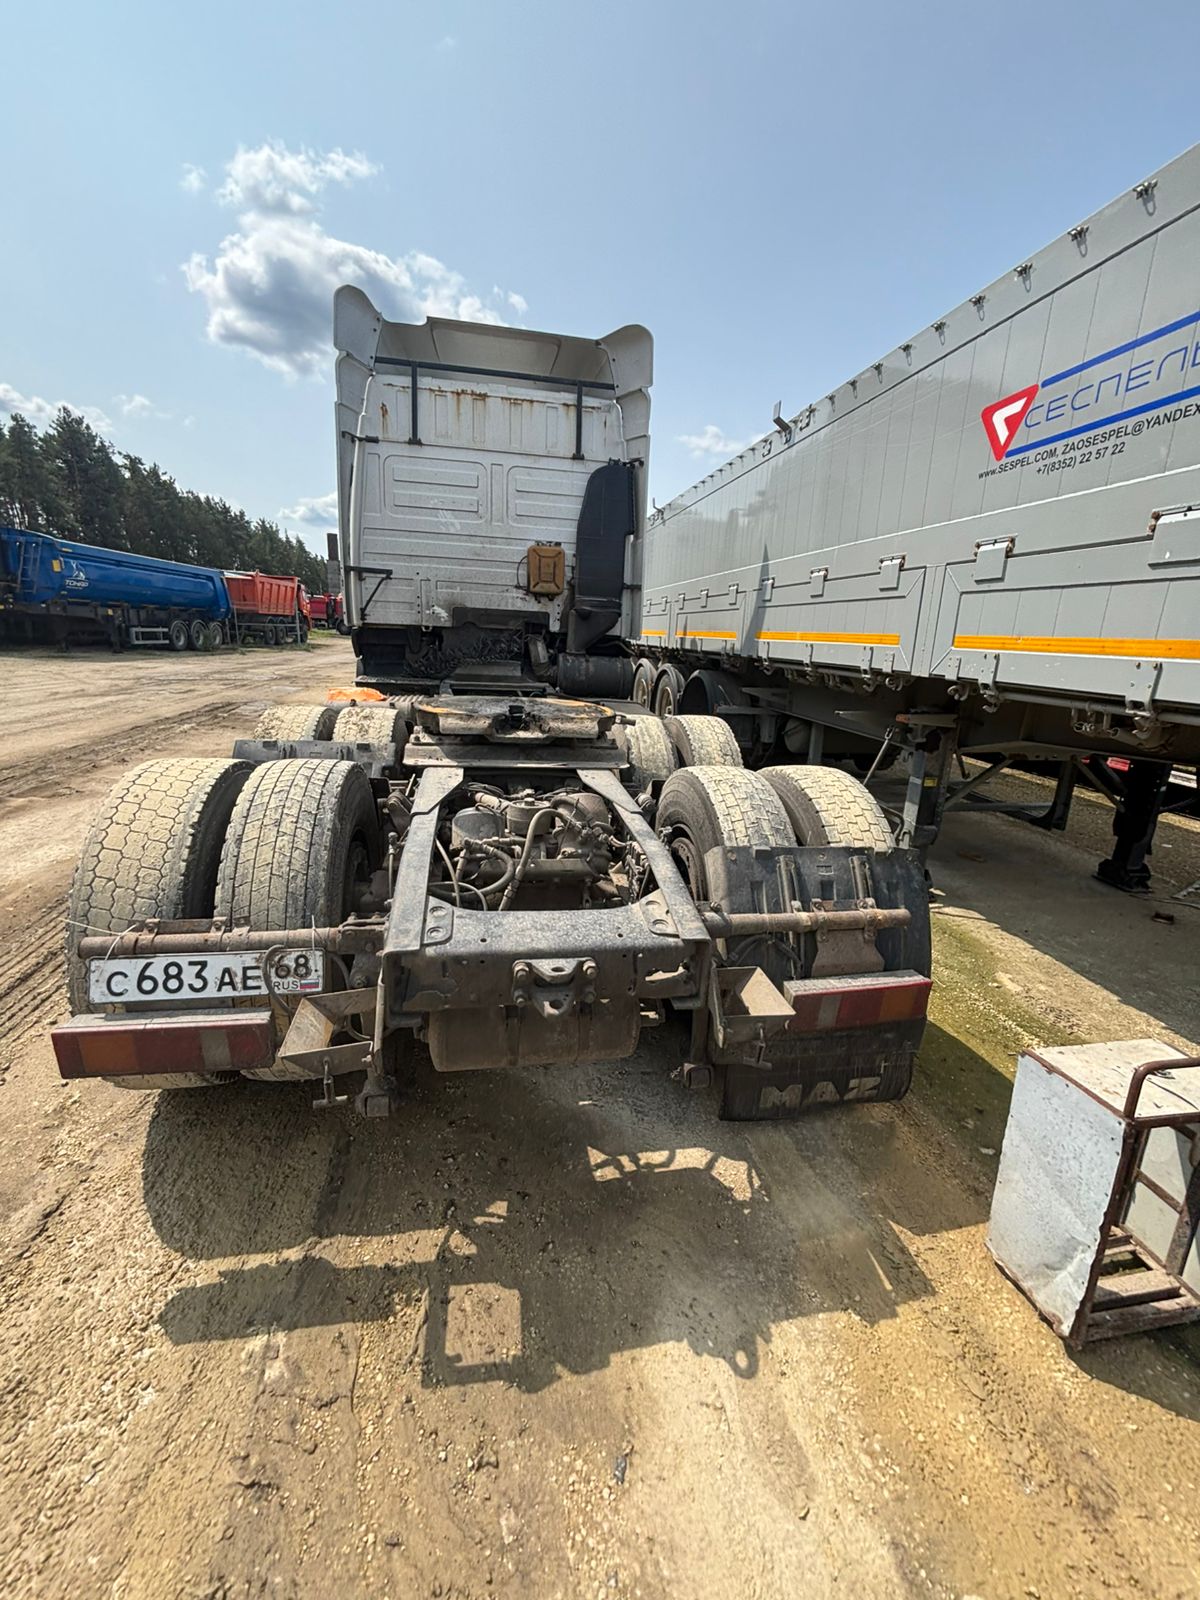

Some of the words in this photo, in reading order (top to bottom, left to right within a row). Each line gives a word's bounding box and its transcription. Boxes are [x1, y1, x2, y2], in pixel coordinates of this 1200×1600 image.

[1036, 455, 1077, 475] +7(8352)
[1079, 453, 1093, 466] 22
[1095, 446, 1110, 460] 57
[1111, 442, 1126, 455] 22
[274, 953, 312, 979] 68
[273, 980, 299, 990] RUS
